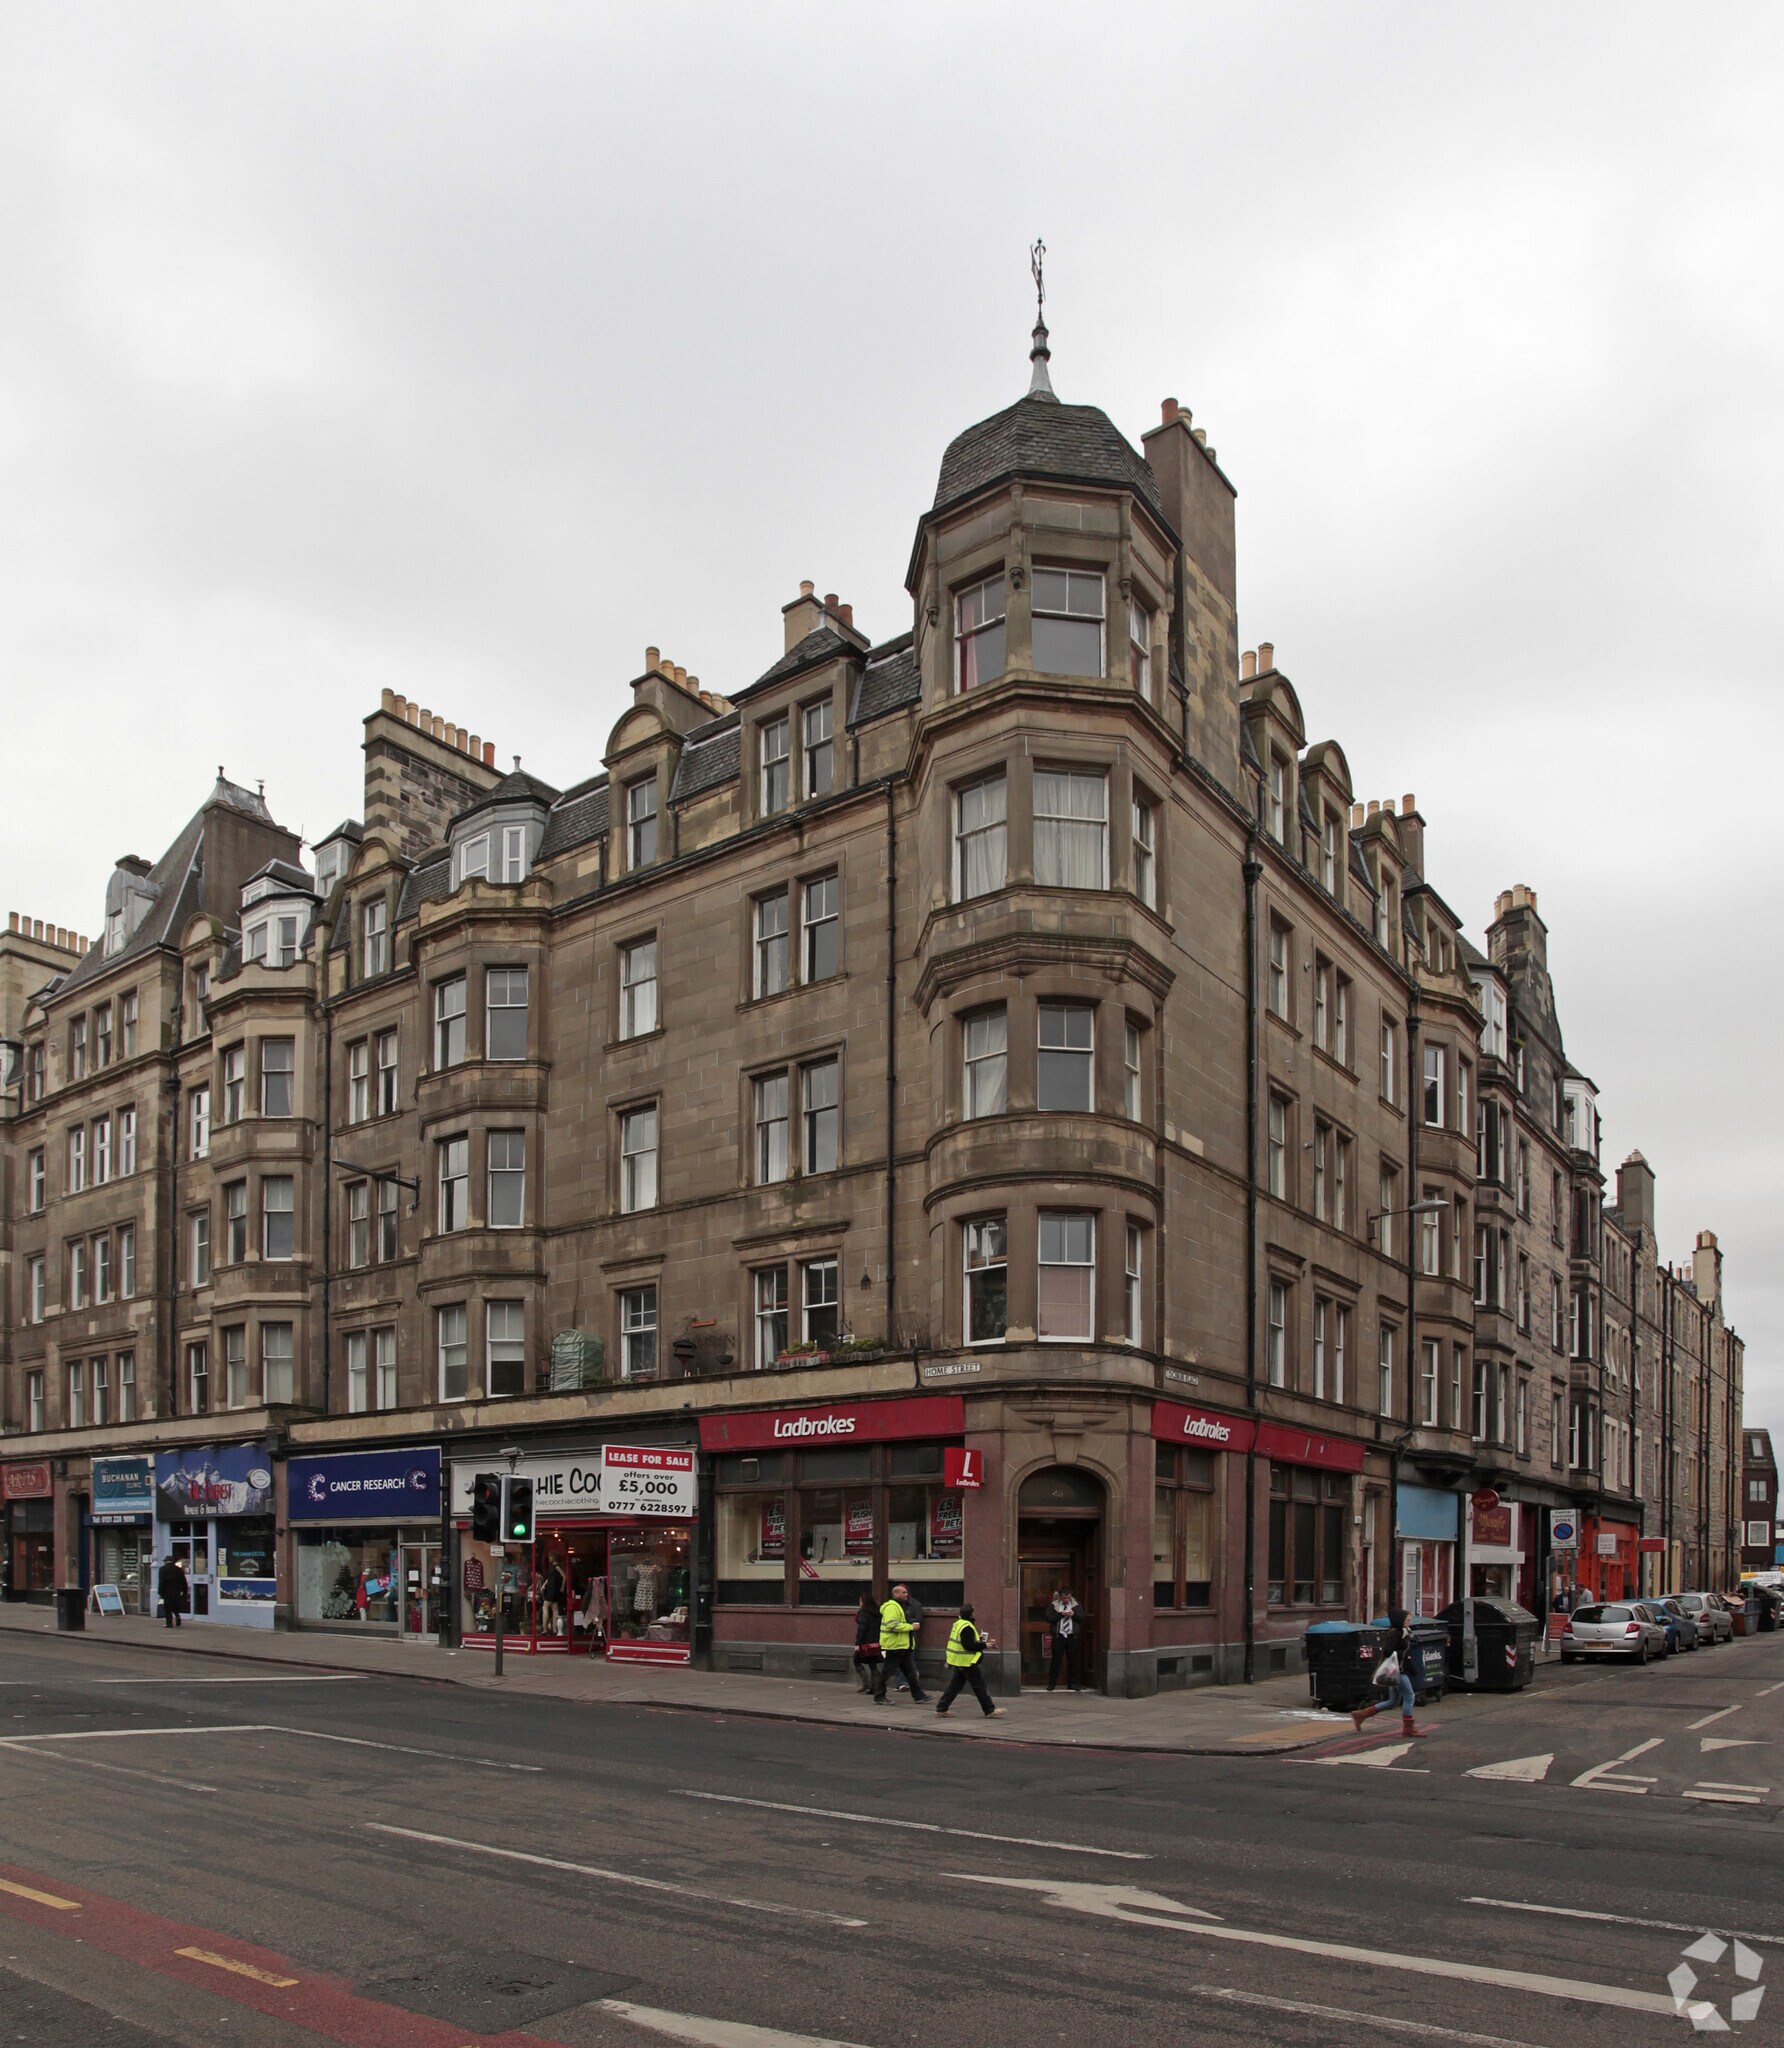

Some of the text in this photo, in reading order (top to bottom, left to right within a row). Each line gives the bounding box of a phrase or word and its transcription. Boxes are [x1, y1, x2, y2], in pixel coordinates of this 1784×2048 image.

[926, 1363, 979, 1376] HOME STREET
[774, 1415, 856, 1438] Ladbrokes
[1184, 1414, 1231, 1442] Ladbrokes
[608, 1452, 690, 1467] LEASE FOR SALE
[963, 1451, 974, 1478] L
[102, 1473, 139, 1483] BUCHANAN
[536, 1467, 602, 1495] HIE CO
[623, 1471, 675, 1481] offers over
[330, 1480, 362, 1492] CANCER
[363, 1479, 406, 1490] RESEARCH
[619, 1479, 678, 1495] £5,000
[956, 1478, 980, 1488] Ladbrokes
[608, 1501, 688, 1513] 0777 6228597
[938, 1497, 954, 1511] £5
[938, 1510, 961, 1520] FREE
[944, 1519, 961, 1529] BET
